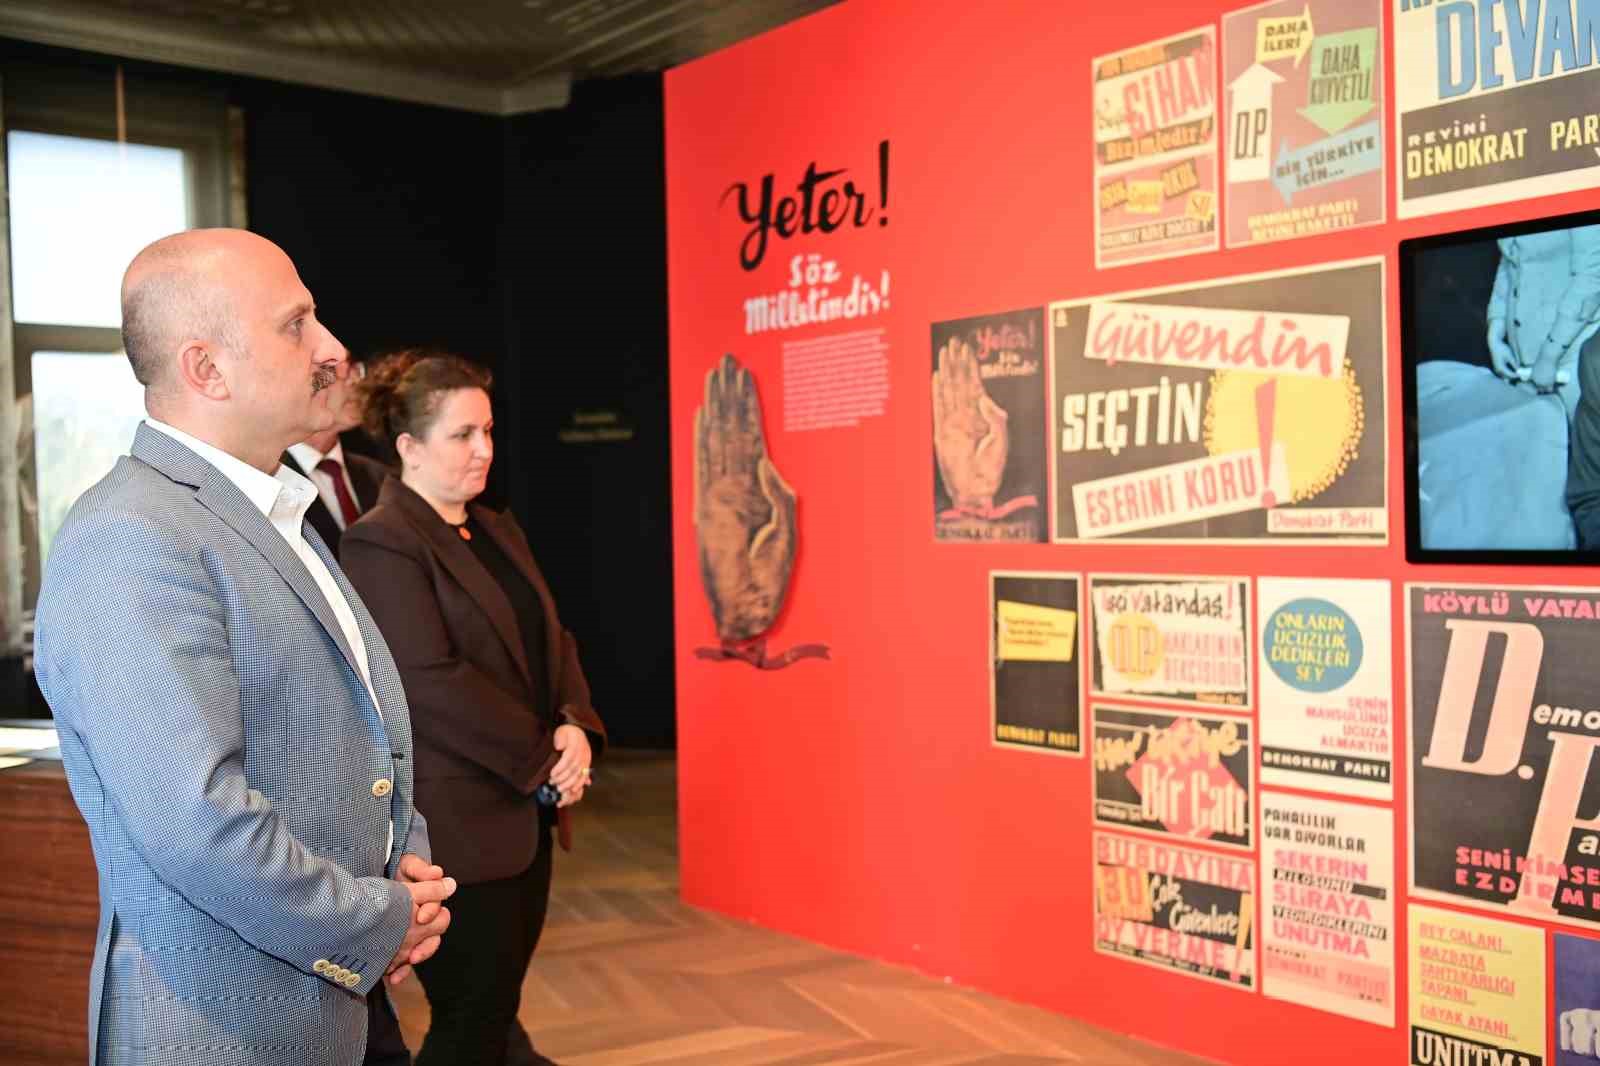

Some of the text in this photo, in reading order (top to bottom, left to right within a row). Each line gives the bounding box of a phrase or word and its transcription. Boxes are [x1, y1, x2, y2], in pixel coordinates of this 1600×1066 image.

[1265, 20, 1308, 37] DAHA
[1321, 44, 1361, 75] DAHA
[1406, 113, 1600, 179] DEMOKRAT PAR
[1407, 114, 1486, 147] REYİNİ
[717, 140, 890, 271] Yeter!
[789, 253, 842, 287] Söz
[1091, 311, 1333, 378] Güvendin
[1061, 376, 1203, 457] SEÇTİN
[1085, 474, 1176, 529] ESERİNİ
[1423, 590, 1510, 616] KÖYLÜ
[1275, 612, 1345, 631] ONLARIN
[1262, 750, 1338, 771] DEMOKRAT
[1455, 846, 1513, 872] SENİ
[1272, 920, 1371, 960] UNUTMA
